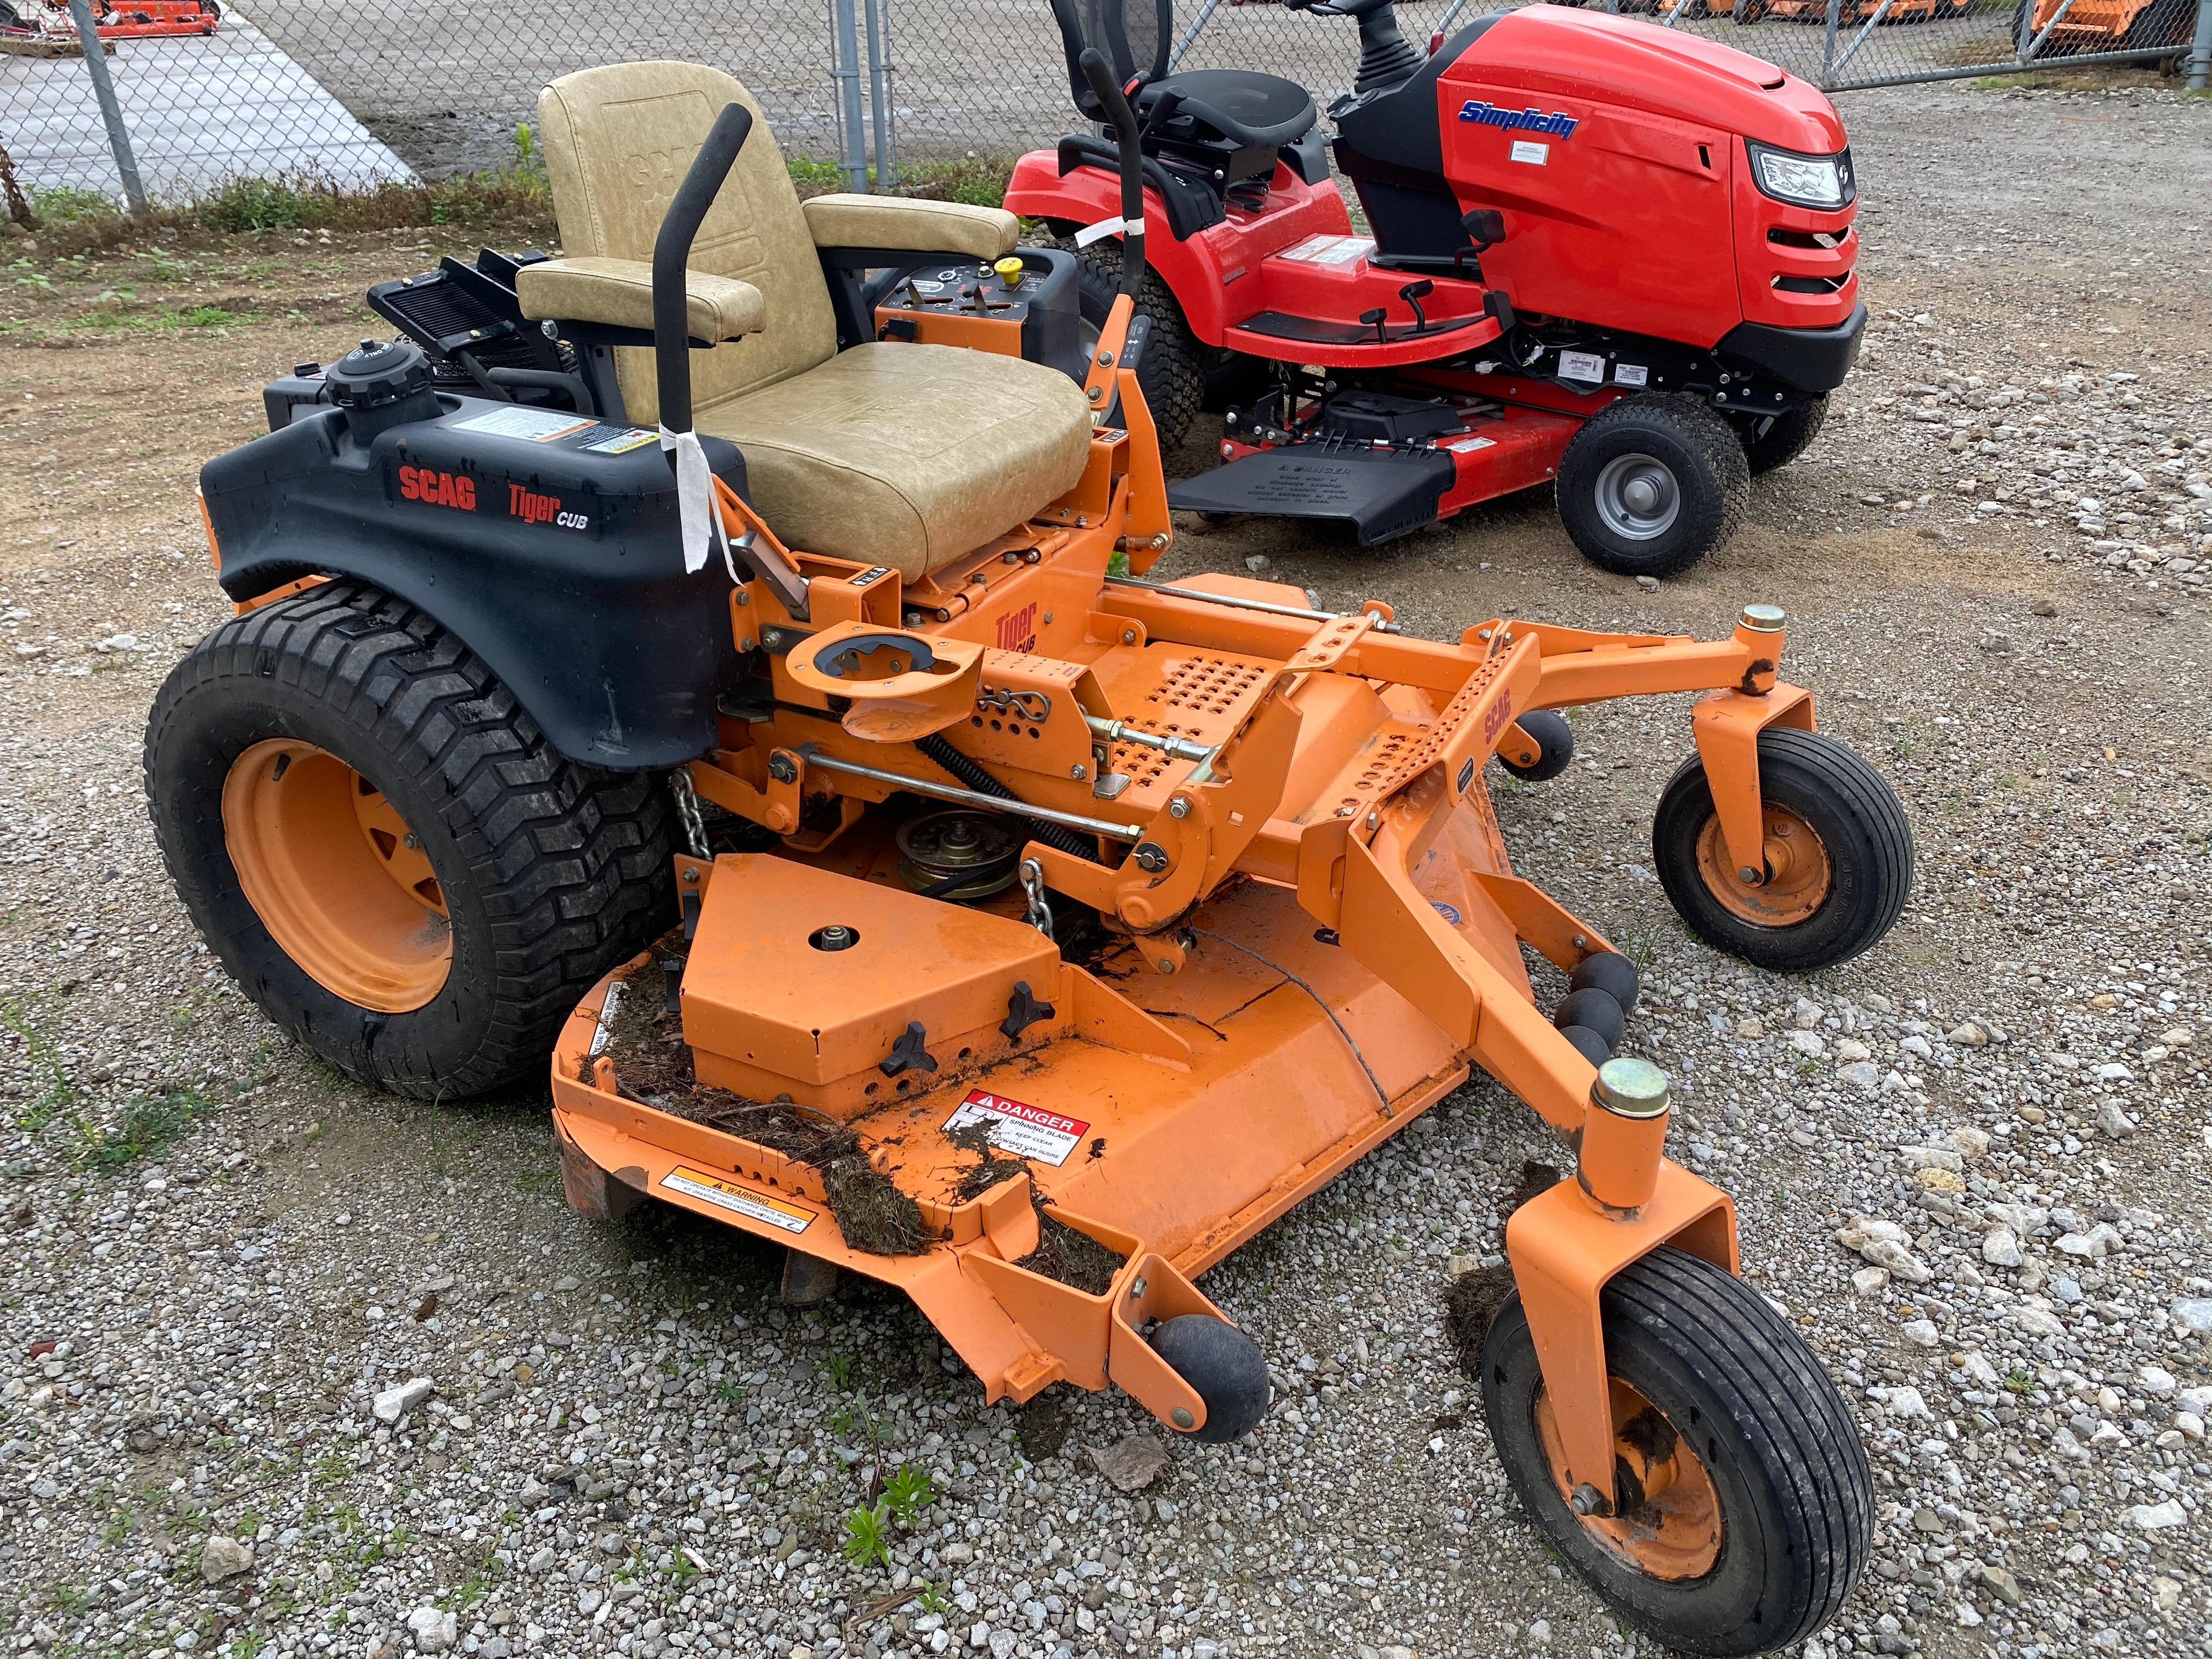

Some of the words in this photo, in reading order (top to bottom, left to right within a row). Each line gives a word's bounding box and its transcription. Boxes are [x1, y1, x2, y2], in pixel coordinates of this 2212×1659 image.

[1458, 100, 1579, 140] Simplicity
[1294, 466, 1352, 475] DANGER
[399, 465, 476, 511] SCAG
[509, 483, 561, 523] Tiger
[556, 512, 589, 529] CUB
[996, 601, 1037, 652] Tiger
[1016, 634, 1036, 653] CUB
[1485, 688, 1511, 745] SCAG
[606, 984, 619, 1011] DISCHARGE
[996, 1101, 1074, 1132] DANGER
[1009, 1119, 1045, 1133] SPINNING
[1046, 1130, 1073, 1142] BLADE
[996, 1136, 1024, 1149] CONTACT
[1024, 1144, 1037, 1153] CAN
[1038, 1149, 1060, 1159] INJURE
[1015, 1131, 1031, 1139] KEEP
[1032, 1137, 1053, 1147] CLEAR
[690, 1182, 712, 1193] OPERATE
[713, 1189, 732, 1200] WITHOUT
[732, 1197, 759, 1210] DISCHARGE
[760, 1206, 776, 1216] CHUTE,
[777, 1212, 802, 1224] MULCHING
[699, 1192, 716, 1201] ENTIRE
[716, 1198, 733, 1207] GRASS
[733, 1203, 755, 1215] CATCHER
[755, 1211, 781, 1223] INSTALLED
[727, 1186, 770, 1206] WARNING
[1536, 1504, 1667, 1620] CARLISLE
